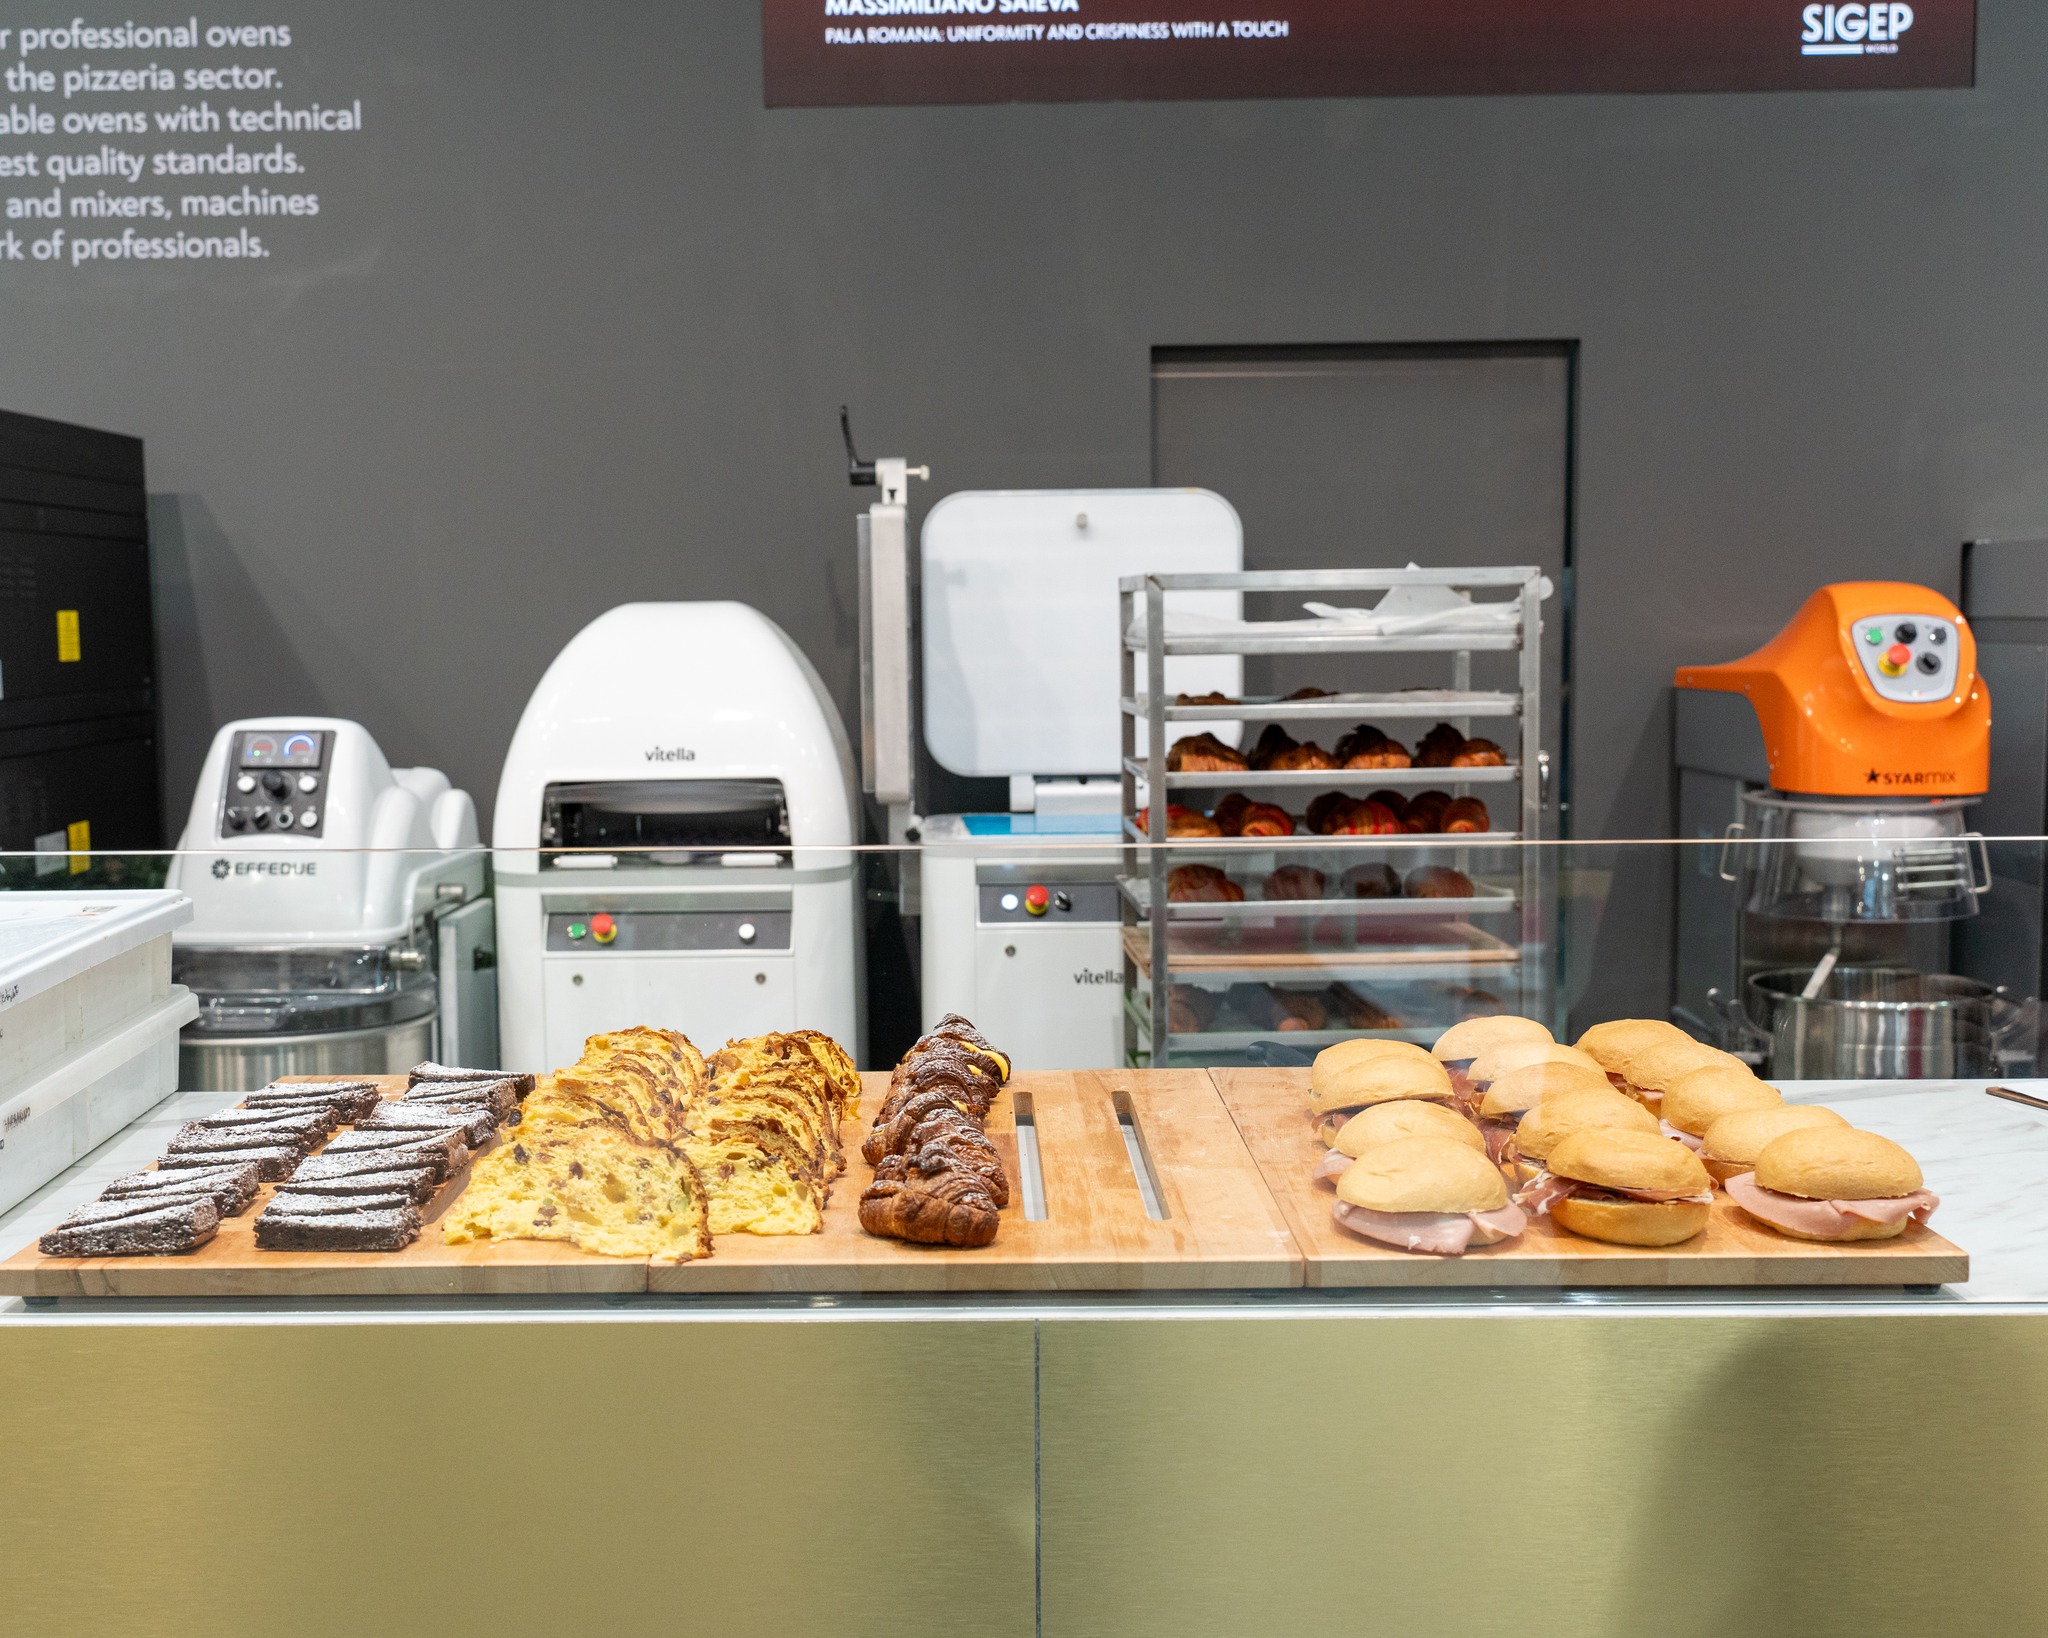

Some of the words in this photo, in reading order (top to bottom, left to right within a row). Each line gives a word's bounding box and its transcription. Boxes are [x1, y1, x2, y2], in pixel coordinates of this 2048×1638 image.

[824, 0, 996, 16] MASSIMILIANO
[998, 0, 1080, 14] SAIEVA
[1801, 2, 1914, 43] SIGEP
[19, 16, 198, 58] professional
[205, 25, 292, 48] ovens
[824, 27, 866, 44] PALA
[866, 26, 945, 44] ROMANA:
[946, 23, 1046, 43] UNIFORMITY
[1046, 23, 1085, 41] AND
[1084, 21, 1170, 41] CRISPINESS
[1170, 21, 1215, 39] WITH
[1215, 21, 1230, 38] A
[1231, 20, 1289, 38] TOUCH
[3, 60, 56, 93] the
[63, 62, 176, 100] pizzeria
[183, 64, 283, 91] sector.
[61, 111, 148, 135] ovens
[154, 101, 221, 133] with
[226, 99, 362, 133] technical
[45, 144, 146, 184] quality
[152, 142, 305, 176] standards.
[5, 186, 62, 219] and
[69, 189, 173, 221] mixers,
[180, 184, 320, 217] machines
[31, 228, 66, 261] of
[71, 226, 270, 268] professionals.
[645, 745, 696, 762] vitella
[234, 861, 316, 876] EFFEDUE
[1073, 966, 1124, 986] vitella
